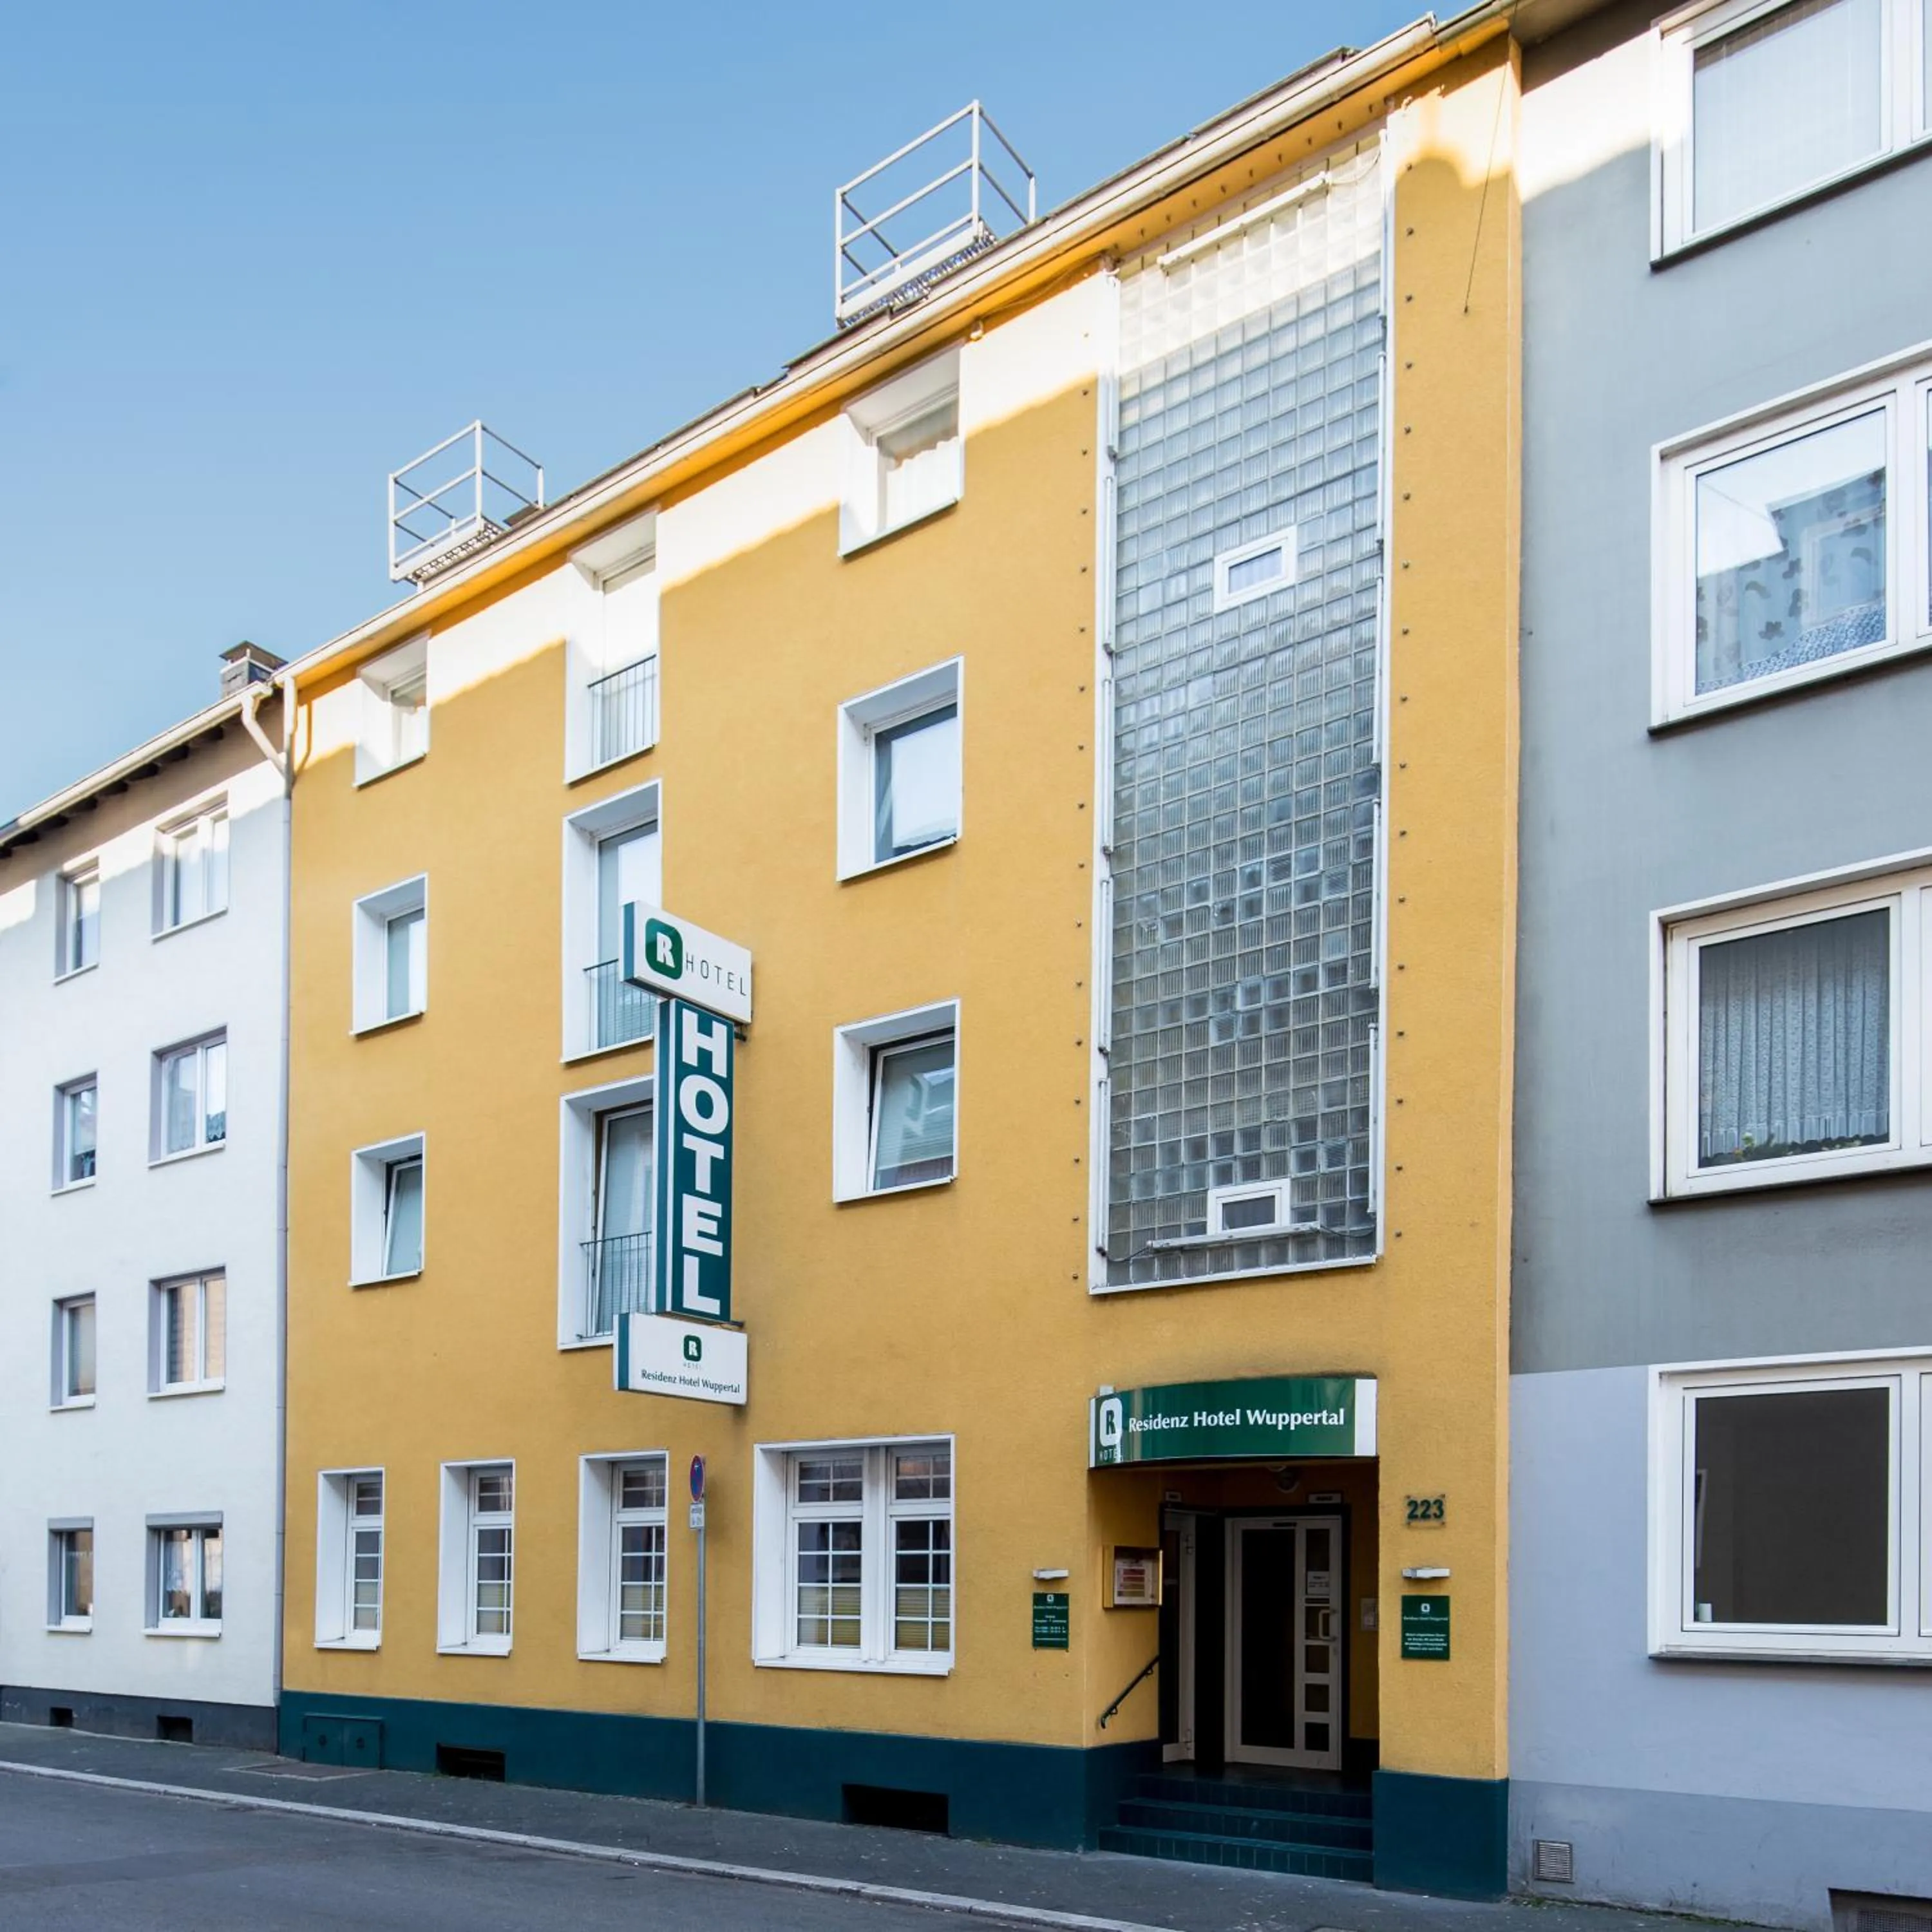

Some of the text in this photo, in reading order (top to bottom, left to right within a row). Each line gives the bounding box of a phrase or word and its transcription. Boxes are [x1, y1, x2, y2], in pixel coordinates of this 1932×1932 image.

[656, 931, 746, 996] R HOTEL
[679, 1007, 729, 1316] HOTEL
[688, 1340, 699, 1357] R
[641, 1368, 740, 1394] Residenz Hotel Wuppertal
[1106, 1410, 1116, 1435] R
[1129, 1408, 1345, 1433] Residenz Hotel Wuppertal
[1407, 1499, 1444, 1520] 223
